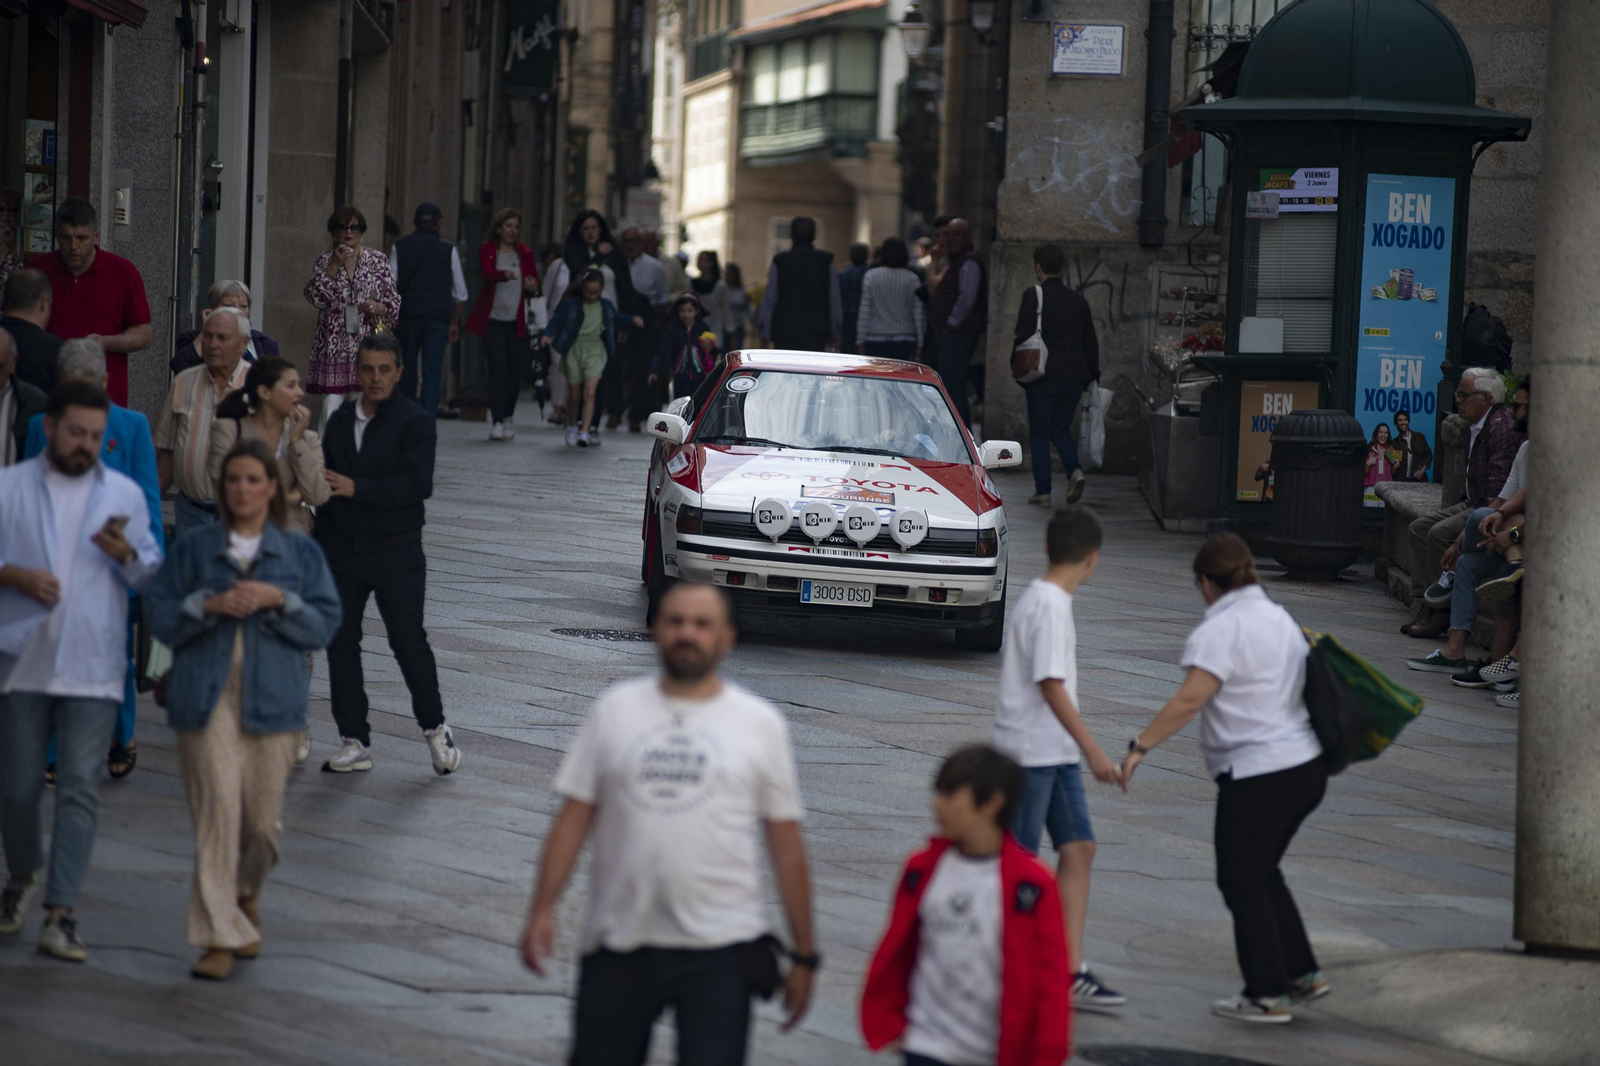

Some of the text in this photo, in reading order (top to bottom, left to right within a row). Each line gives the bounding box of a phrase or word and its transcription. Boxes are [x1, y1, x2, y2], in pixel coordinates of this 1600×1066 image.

[1264, 180, 1294, 189] JACKPOT
[1304, 171, 1331, 179] VIERNES
[1388, 192, 1431, 224] BEN
[1371, 223, 1445, 250] XOGADO
[1379, 358, 1422, 389] BEN
[1262, 393, 1293, 415] BEN
[1363, 388, 1436, 415] XOGADO
[803, 474, 940, 495] TOYOTA
[831, 494, 891, 503] OURENSE
[813, 585, 871, 603] 3003 DSD
